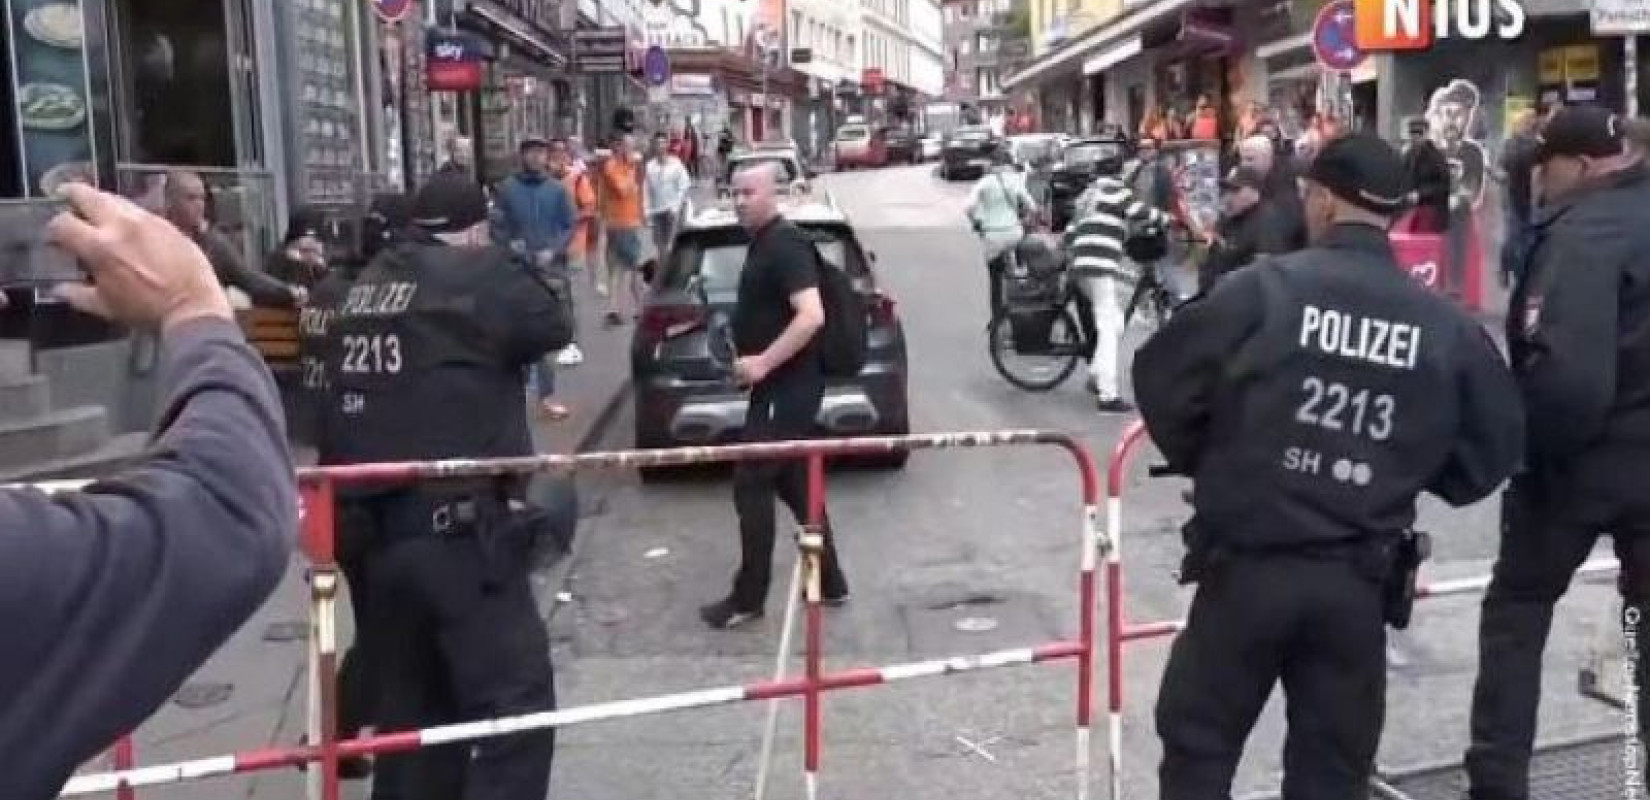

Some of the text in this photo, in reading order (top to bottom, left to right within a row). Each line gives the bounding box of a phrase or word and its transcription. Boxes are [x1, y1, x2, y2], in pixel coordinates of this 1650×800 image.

[436, 41, 464, 61] sky
[341, 282, 417, 316] POLIZEI
[341, 333, 402, 373] 2213
[1299, 305, 1422, 371] POLIZEI
[342, 394, 365, 413] SH
[1296, 375, 1395, 441] 2213
[1282, 446, 1322, 474] SH
